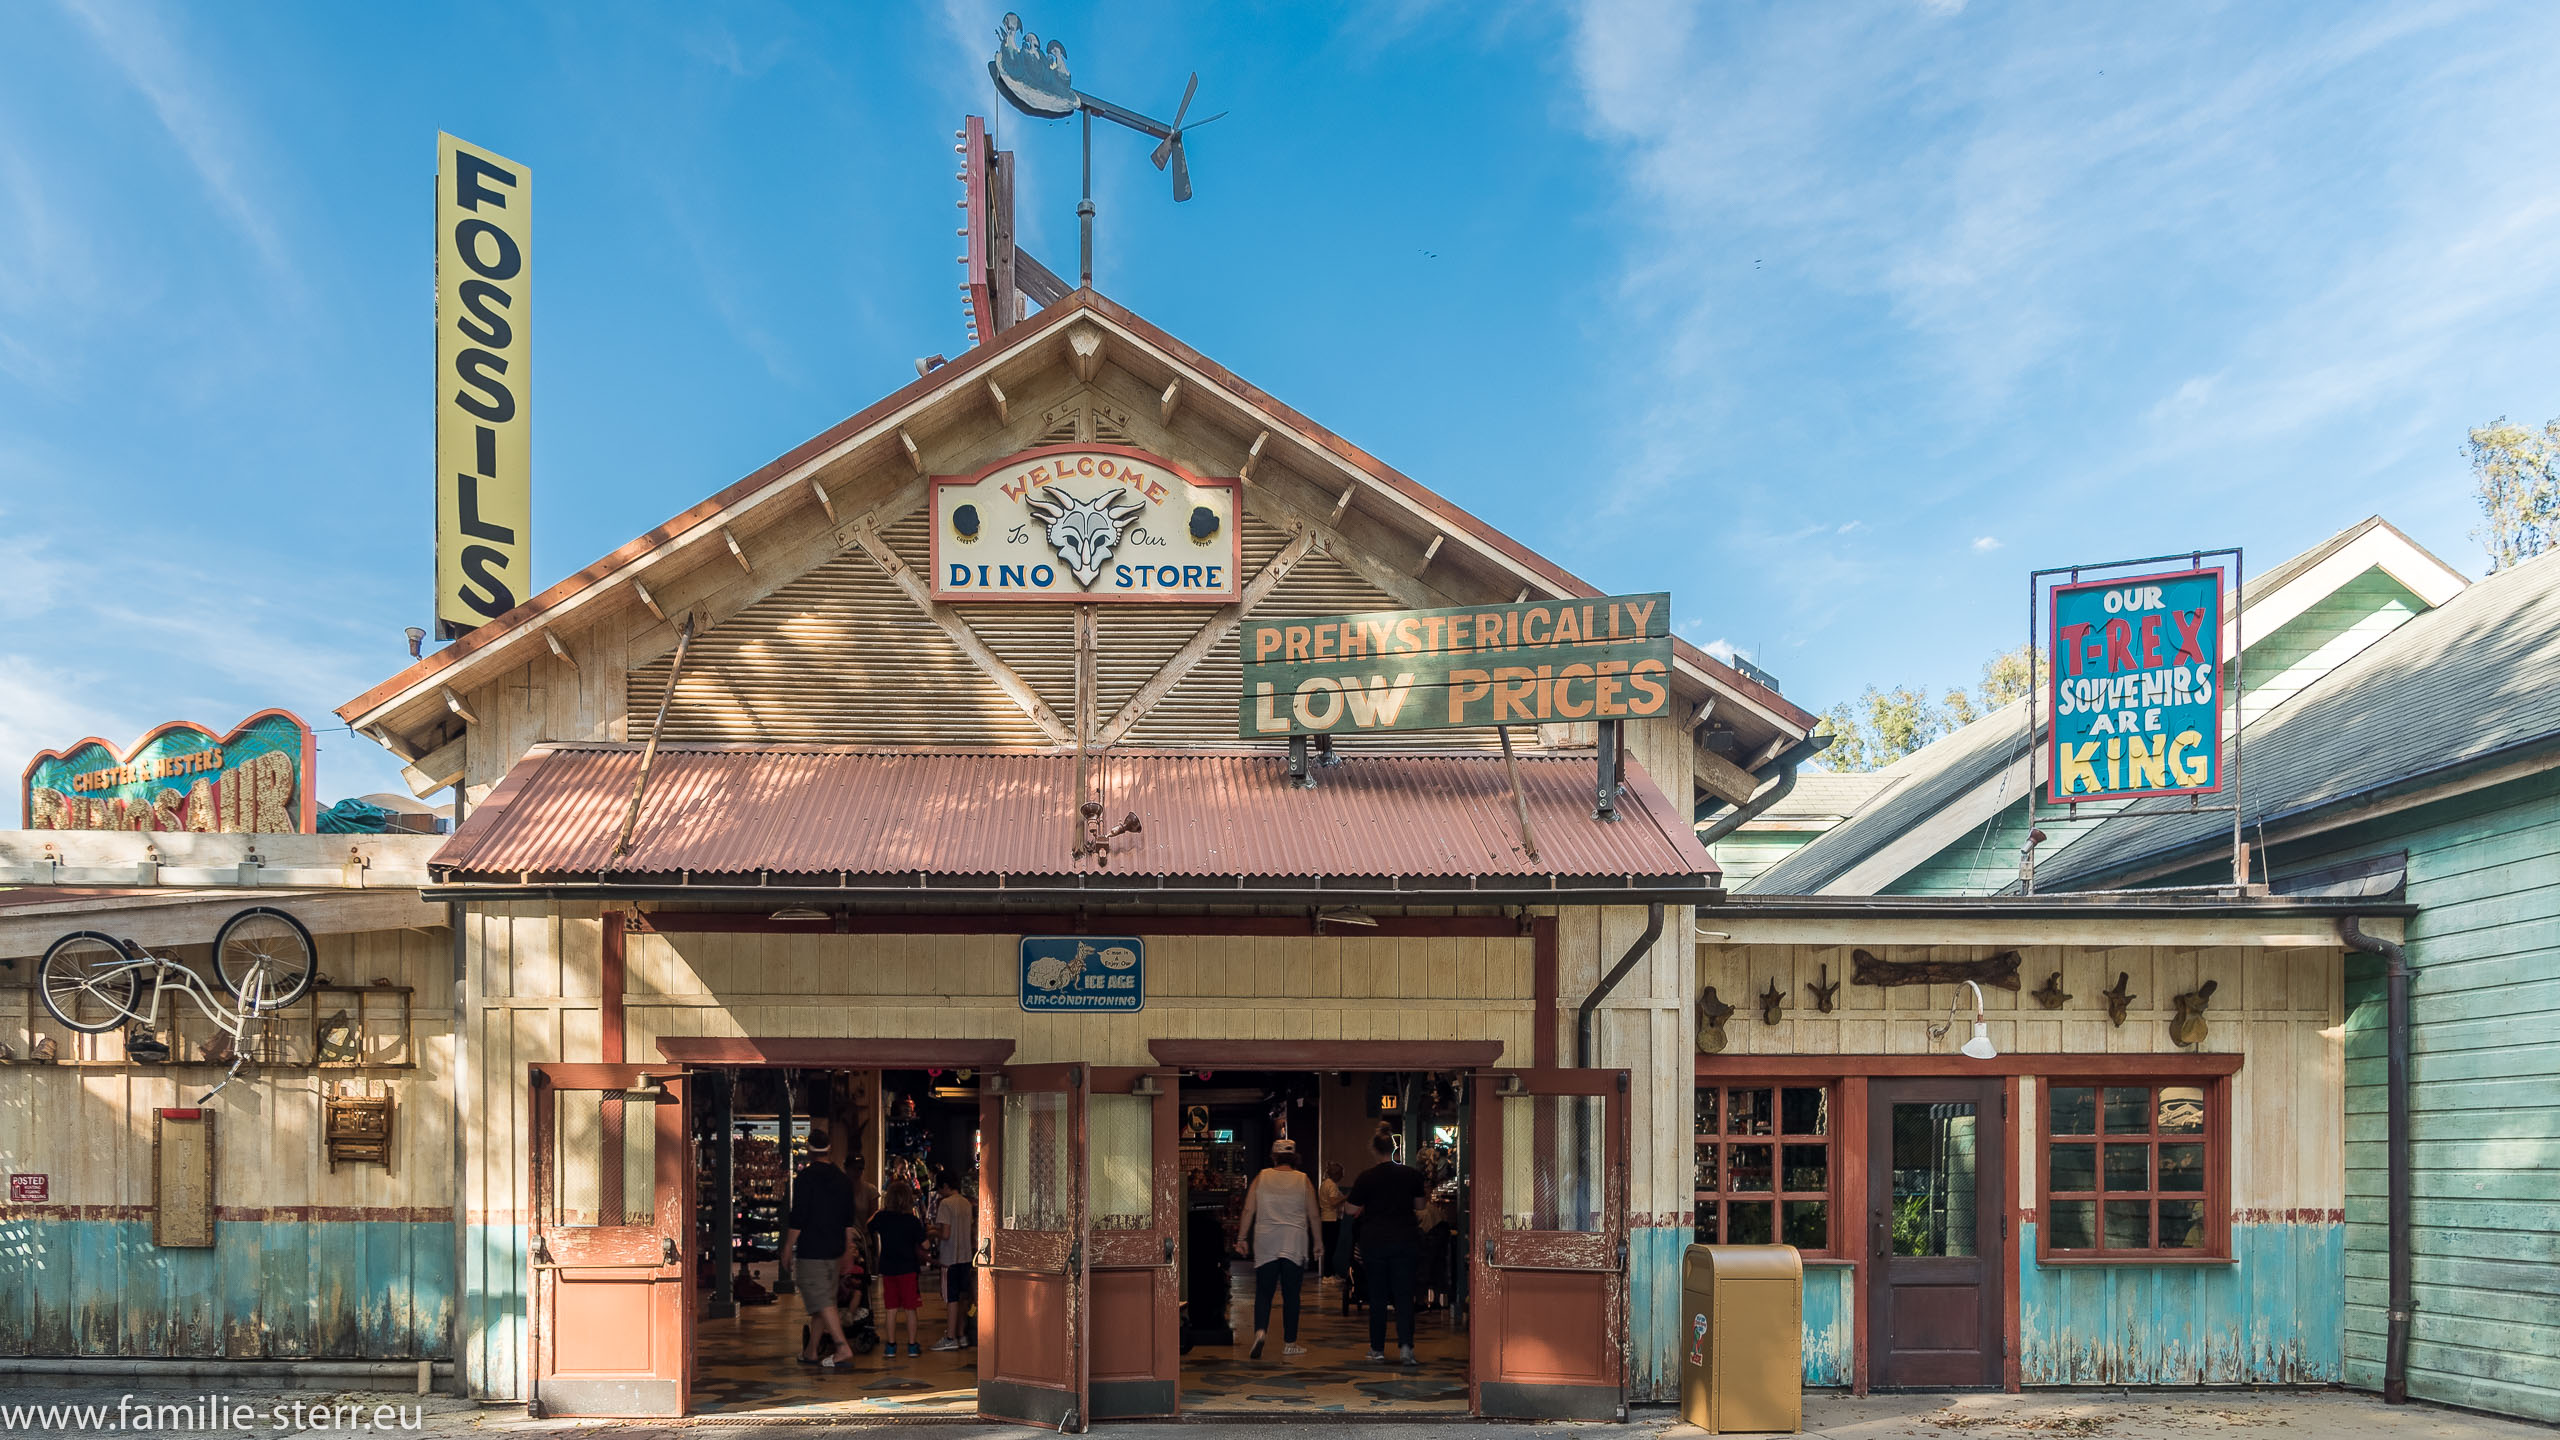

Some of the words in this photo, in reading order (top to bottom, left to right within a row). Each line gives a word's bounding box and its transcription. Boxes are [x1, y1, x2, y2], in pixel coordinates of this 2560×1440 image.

[455, 149, 521, 619] FOSSILS
[1000, 456, 1170, 505] WELCOME
[956, 535, 979, 545] CHESTER
[1007, 524, 1030, 545] To
[1130, 528, 1167, 547] Our
[1192, 539, 1212, 548] HESTER
[950, 563, 1057, 590] DINO
[1115, 564, 1225, 591] STORE
[2103, 586, 2167, 614] OUR
[1255, 600, 1657, 668] PREHYSTERICALLY
[2059, 607, 2206, 677] T-REX
[1255, 672, 1416, 733] LOW
[1448, 659, 1667, 724] PRICES
[2058, 663, 2213, 716] SOUVENIRS
[2088, 708, 2162, 736] ARE
[73, 763, 137, 792] CHESTER
[140, 759, 153, 781] &
[153, 748, 225, 778] HESTER'S
[2060, 730, 2208, 796] KING
[1084, 975, 1105, 989] ICE
[1108, 975, 1136, 989] AGE
[1025, 994, 1136, 1006] AIR-CONDITIONING
[12, 1176, 45, 1185] POSTED
